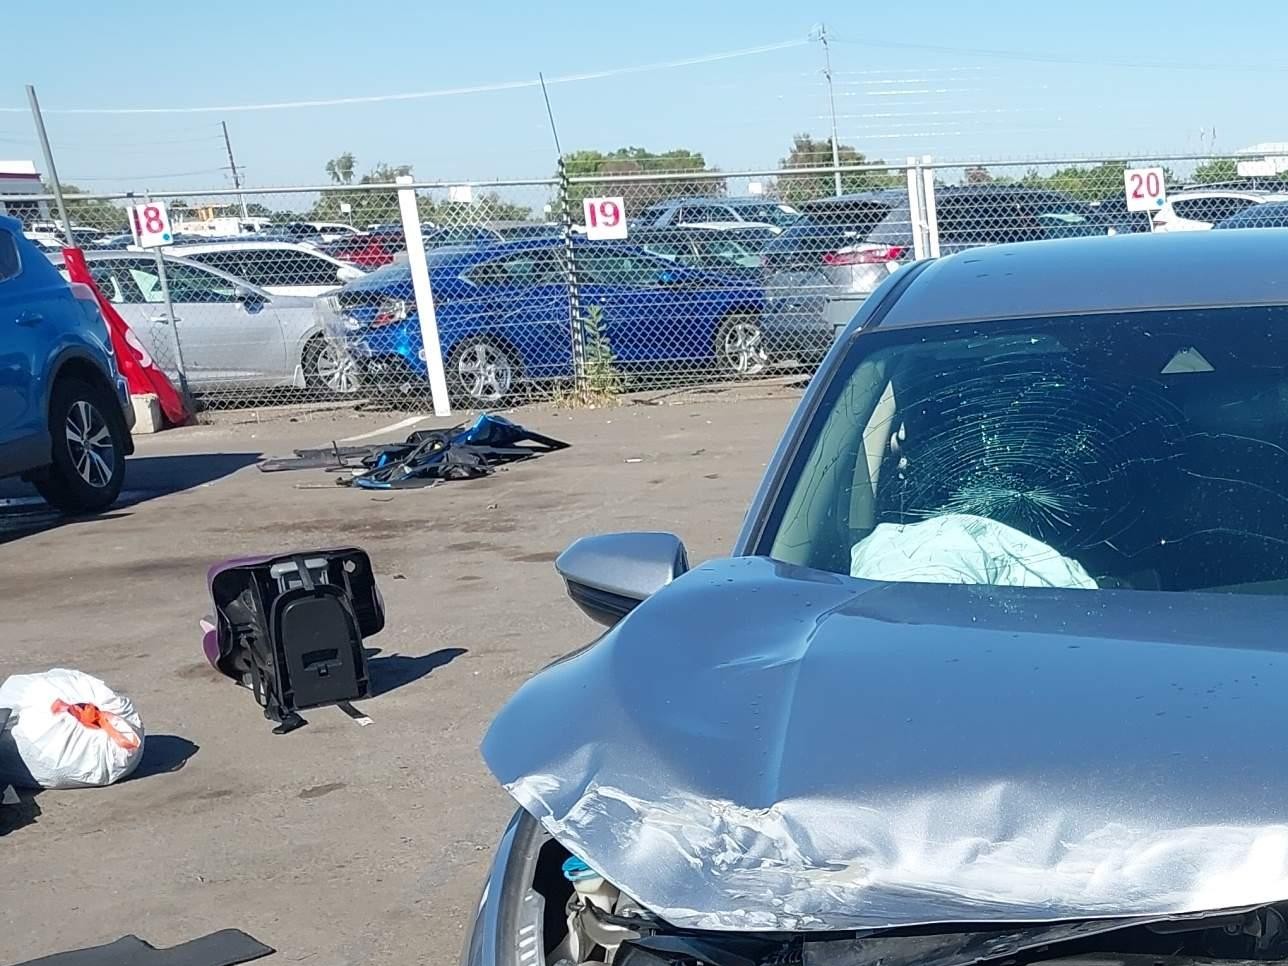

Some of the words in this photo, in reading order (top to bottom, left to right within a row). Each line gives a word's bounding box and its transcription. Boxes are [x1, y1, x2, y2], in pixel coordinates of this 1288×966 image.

[1130, 172, 1160, 199] 20
[132, 206, 164, 237] 18
[590, 201, 620, 227] 19
